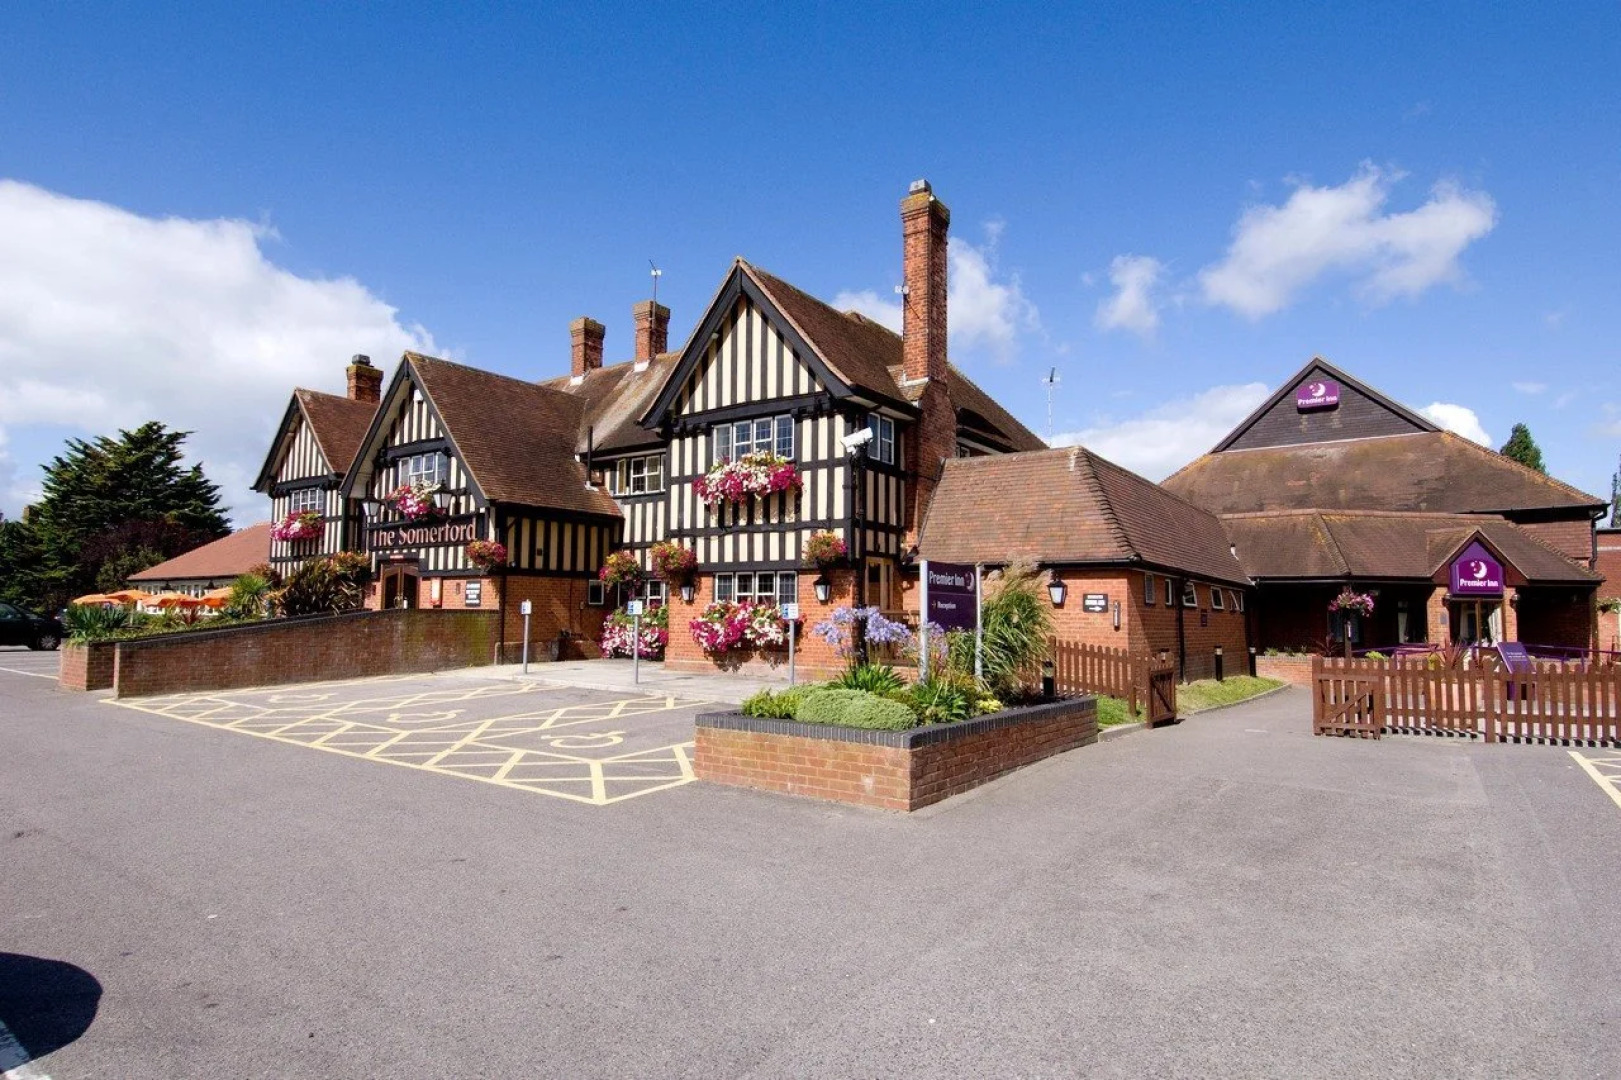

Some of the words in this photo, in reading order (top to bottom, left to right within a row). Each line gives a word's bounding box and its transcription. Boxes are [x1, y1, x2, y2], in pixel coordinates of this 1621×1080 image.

[1297, 396, 1325, 405] Premier
[1325, 395, 1338, 403] Inn
[373, 528, 395, 546] The
[398, 517, 476, 544] Somerford
[929, 570, 954, 586] Premier
[954, 573, 965, 587] Inn
[1459, 578, 1487, 587] Premier
[1487, 579, 1499, 587] Inn
